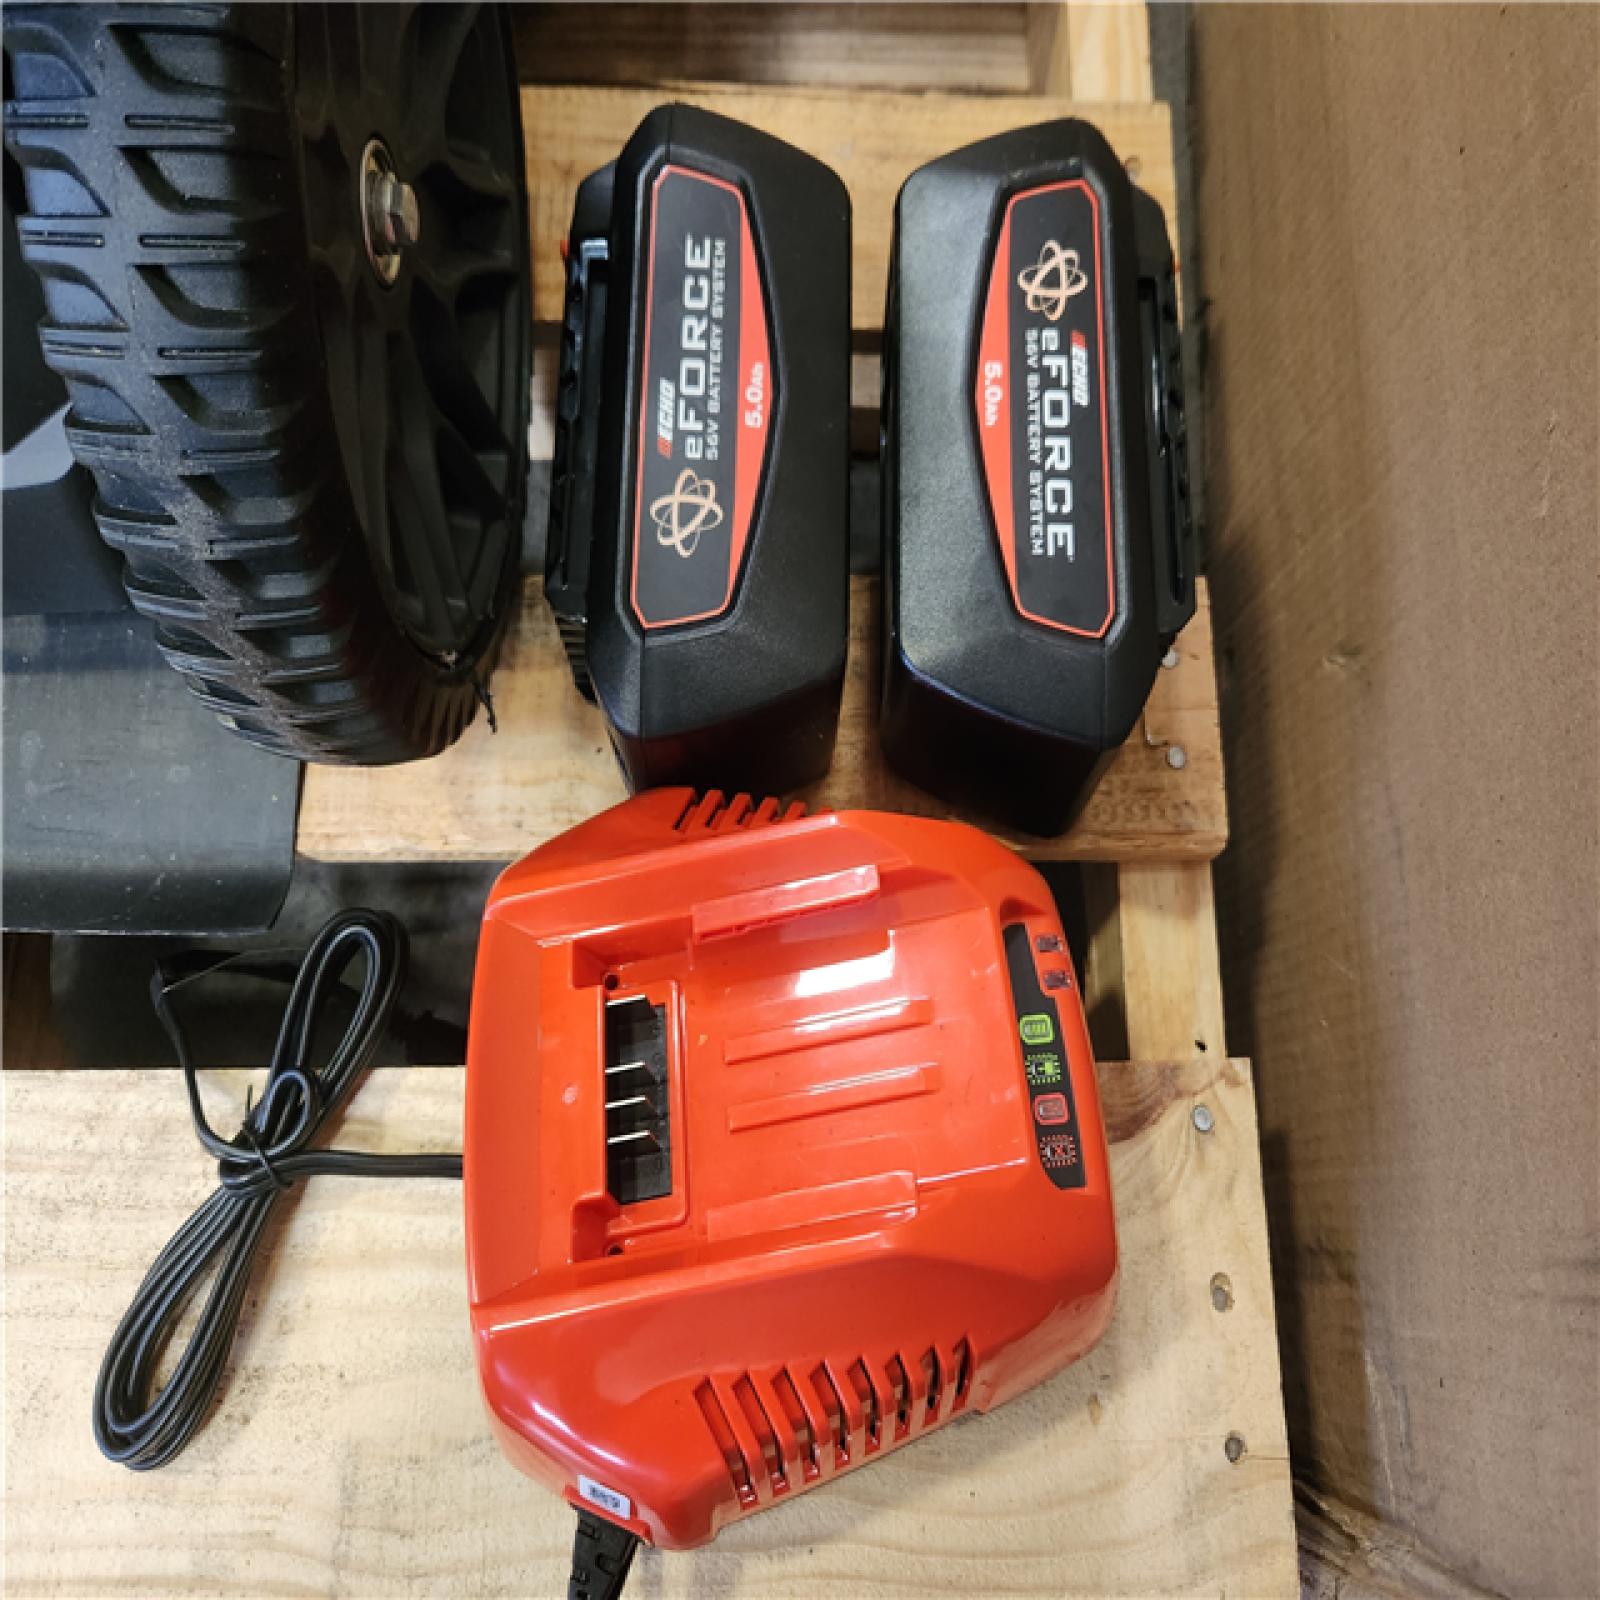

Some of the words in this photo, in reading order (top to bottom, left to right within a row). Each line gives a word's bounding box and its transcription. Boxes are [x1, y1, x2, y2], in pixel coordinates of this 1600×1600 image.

[711, 239, 726, 318] SYSTEM
[678, 233, 711, 459] eFORCE
[709, 325, 723, 412] BATTERY
[1025, 329, 1039, 368] 56V
[1072, 346, 1088, 406] ECHO
[659, 377, 675, 441] ECHO
[707, 419, 719, 459] 56V
[1027, 374, 1041, 463] BATTERY
[1041, 328, 1074, 556] eFORCE
[1030, 470, 1044, 556] SYSTEM
